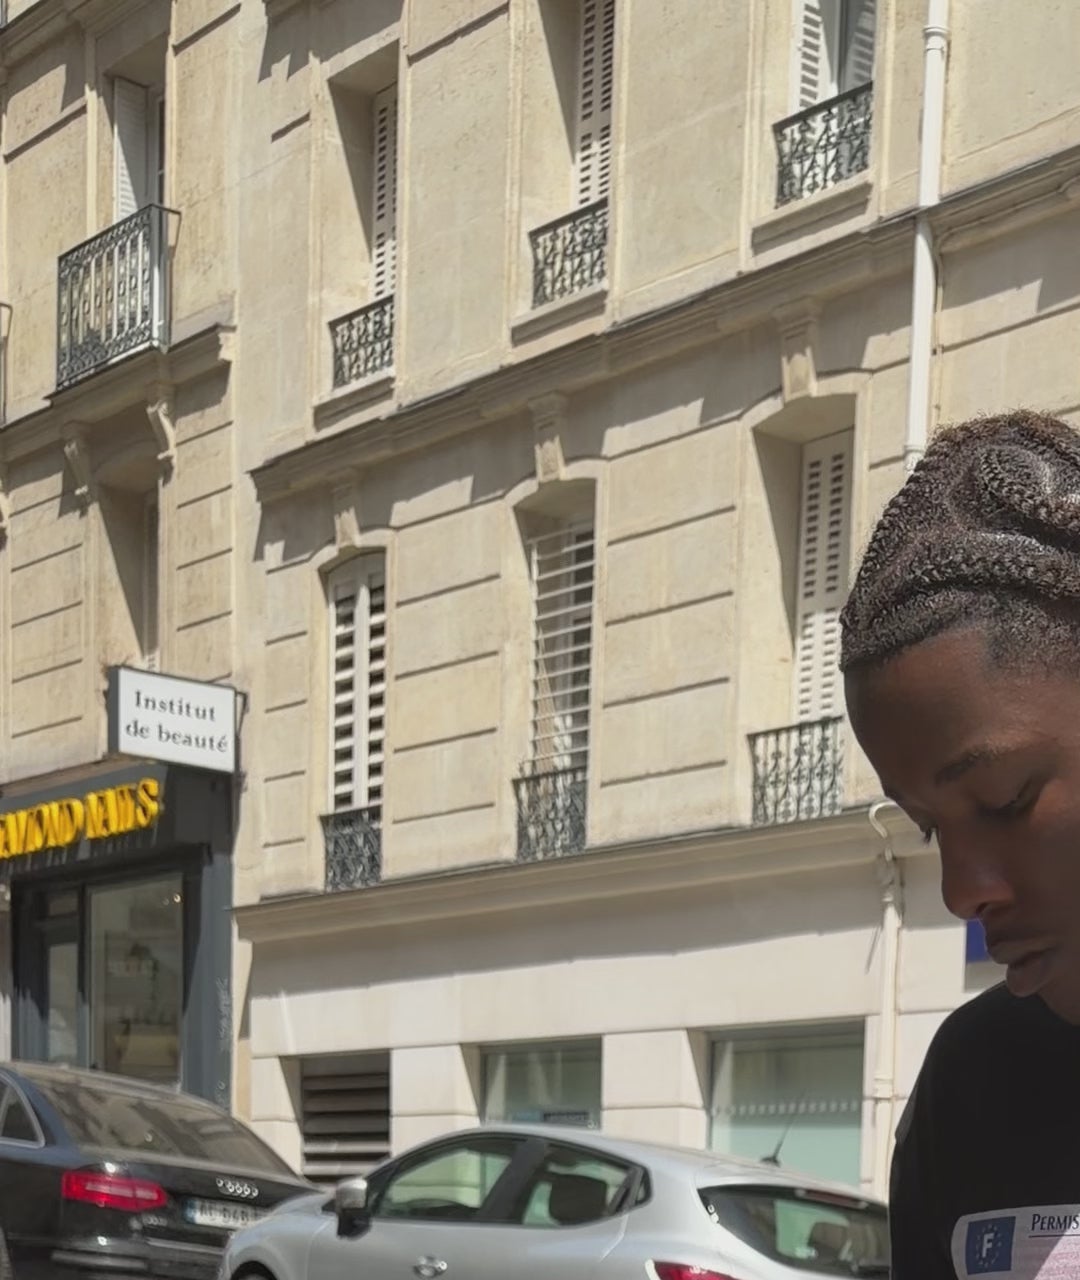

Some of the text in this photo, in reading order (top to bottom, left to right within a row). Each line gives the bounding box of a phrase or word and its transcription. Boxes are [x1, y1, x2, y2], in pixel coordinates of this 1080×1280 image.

[134, 688, 215, 722] Institut
[125, 719, 228, 753] de beauté
[981, 1232, 994, 1258] F
